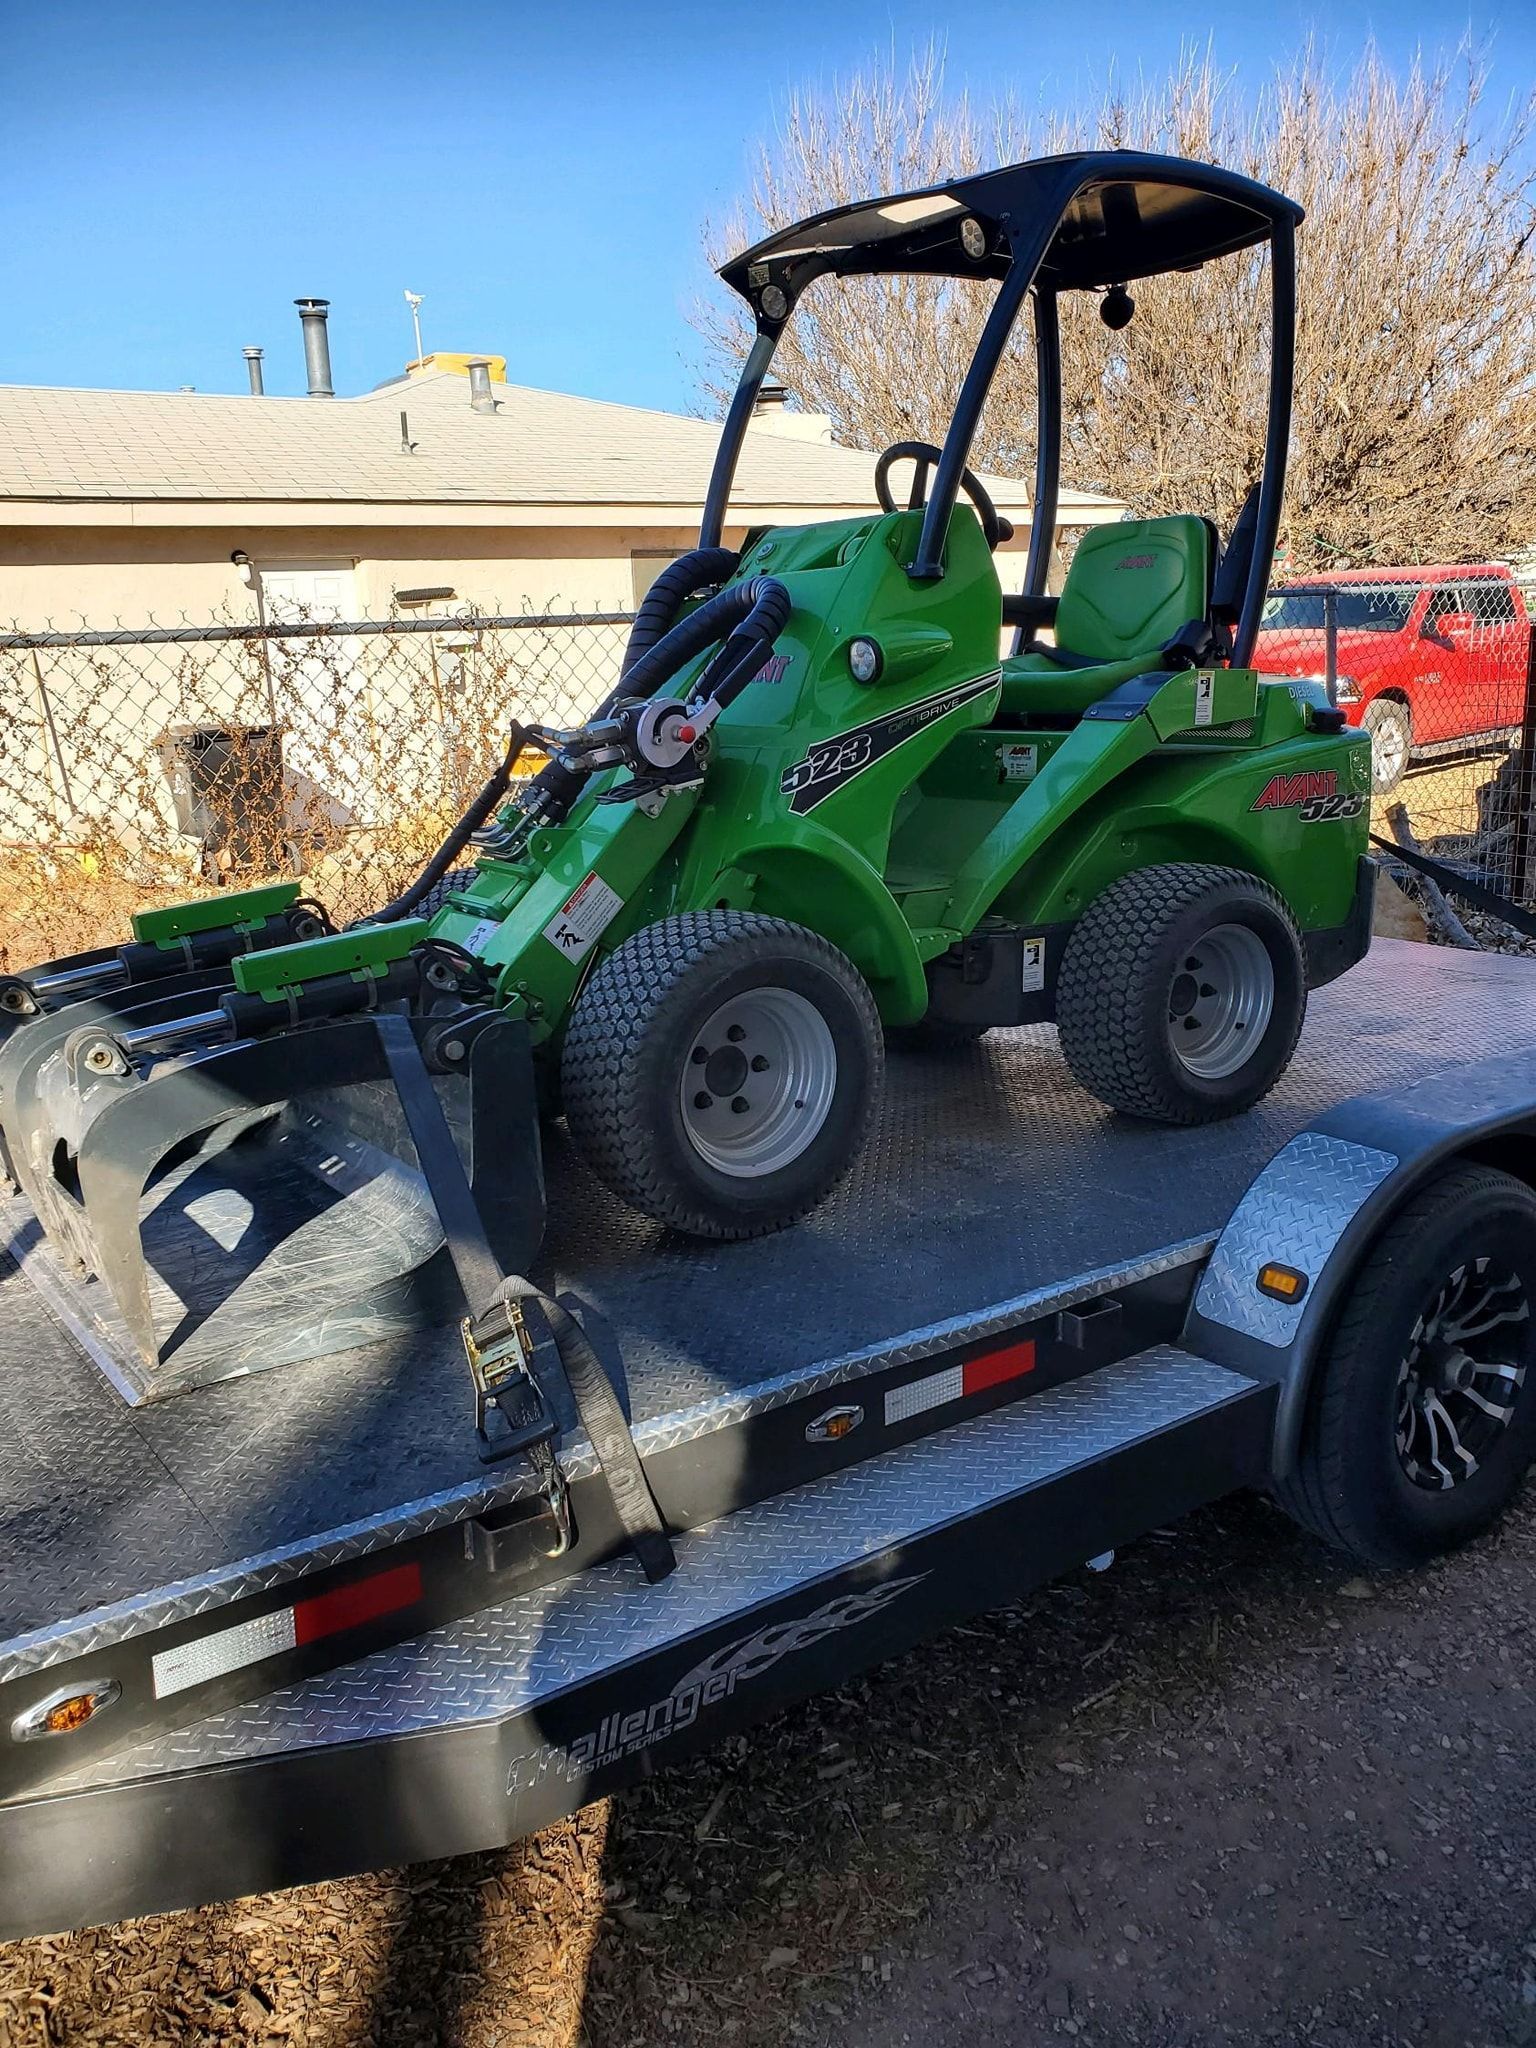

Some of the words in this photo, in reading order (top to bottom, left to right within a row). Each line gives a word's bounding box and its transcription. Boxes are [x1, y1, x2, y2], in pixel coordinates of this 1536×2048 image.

[1288, 686, 1315, 699] DIESEL
[779, 733, 872, 794] 523
[1249, 769, 1338, 812] AVANT
[1298, 791, 1367, 823] 523
[506, 1663, 748, 1796] Challenger
[566, 1747, 623, 1783] CUSTOM
[627, 1724, 673, 1756] SERIES
